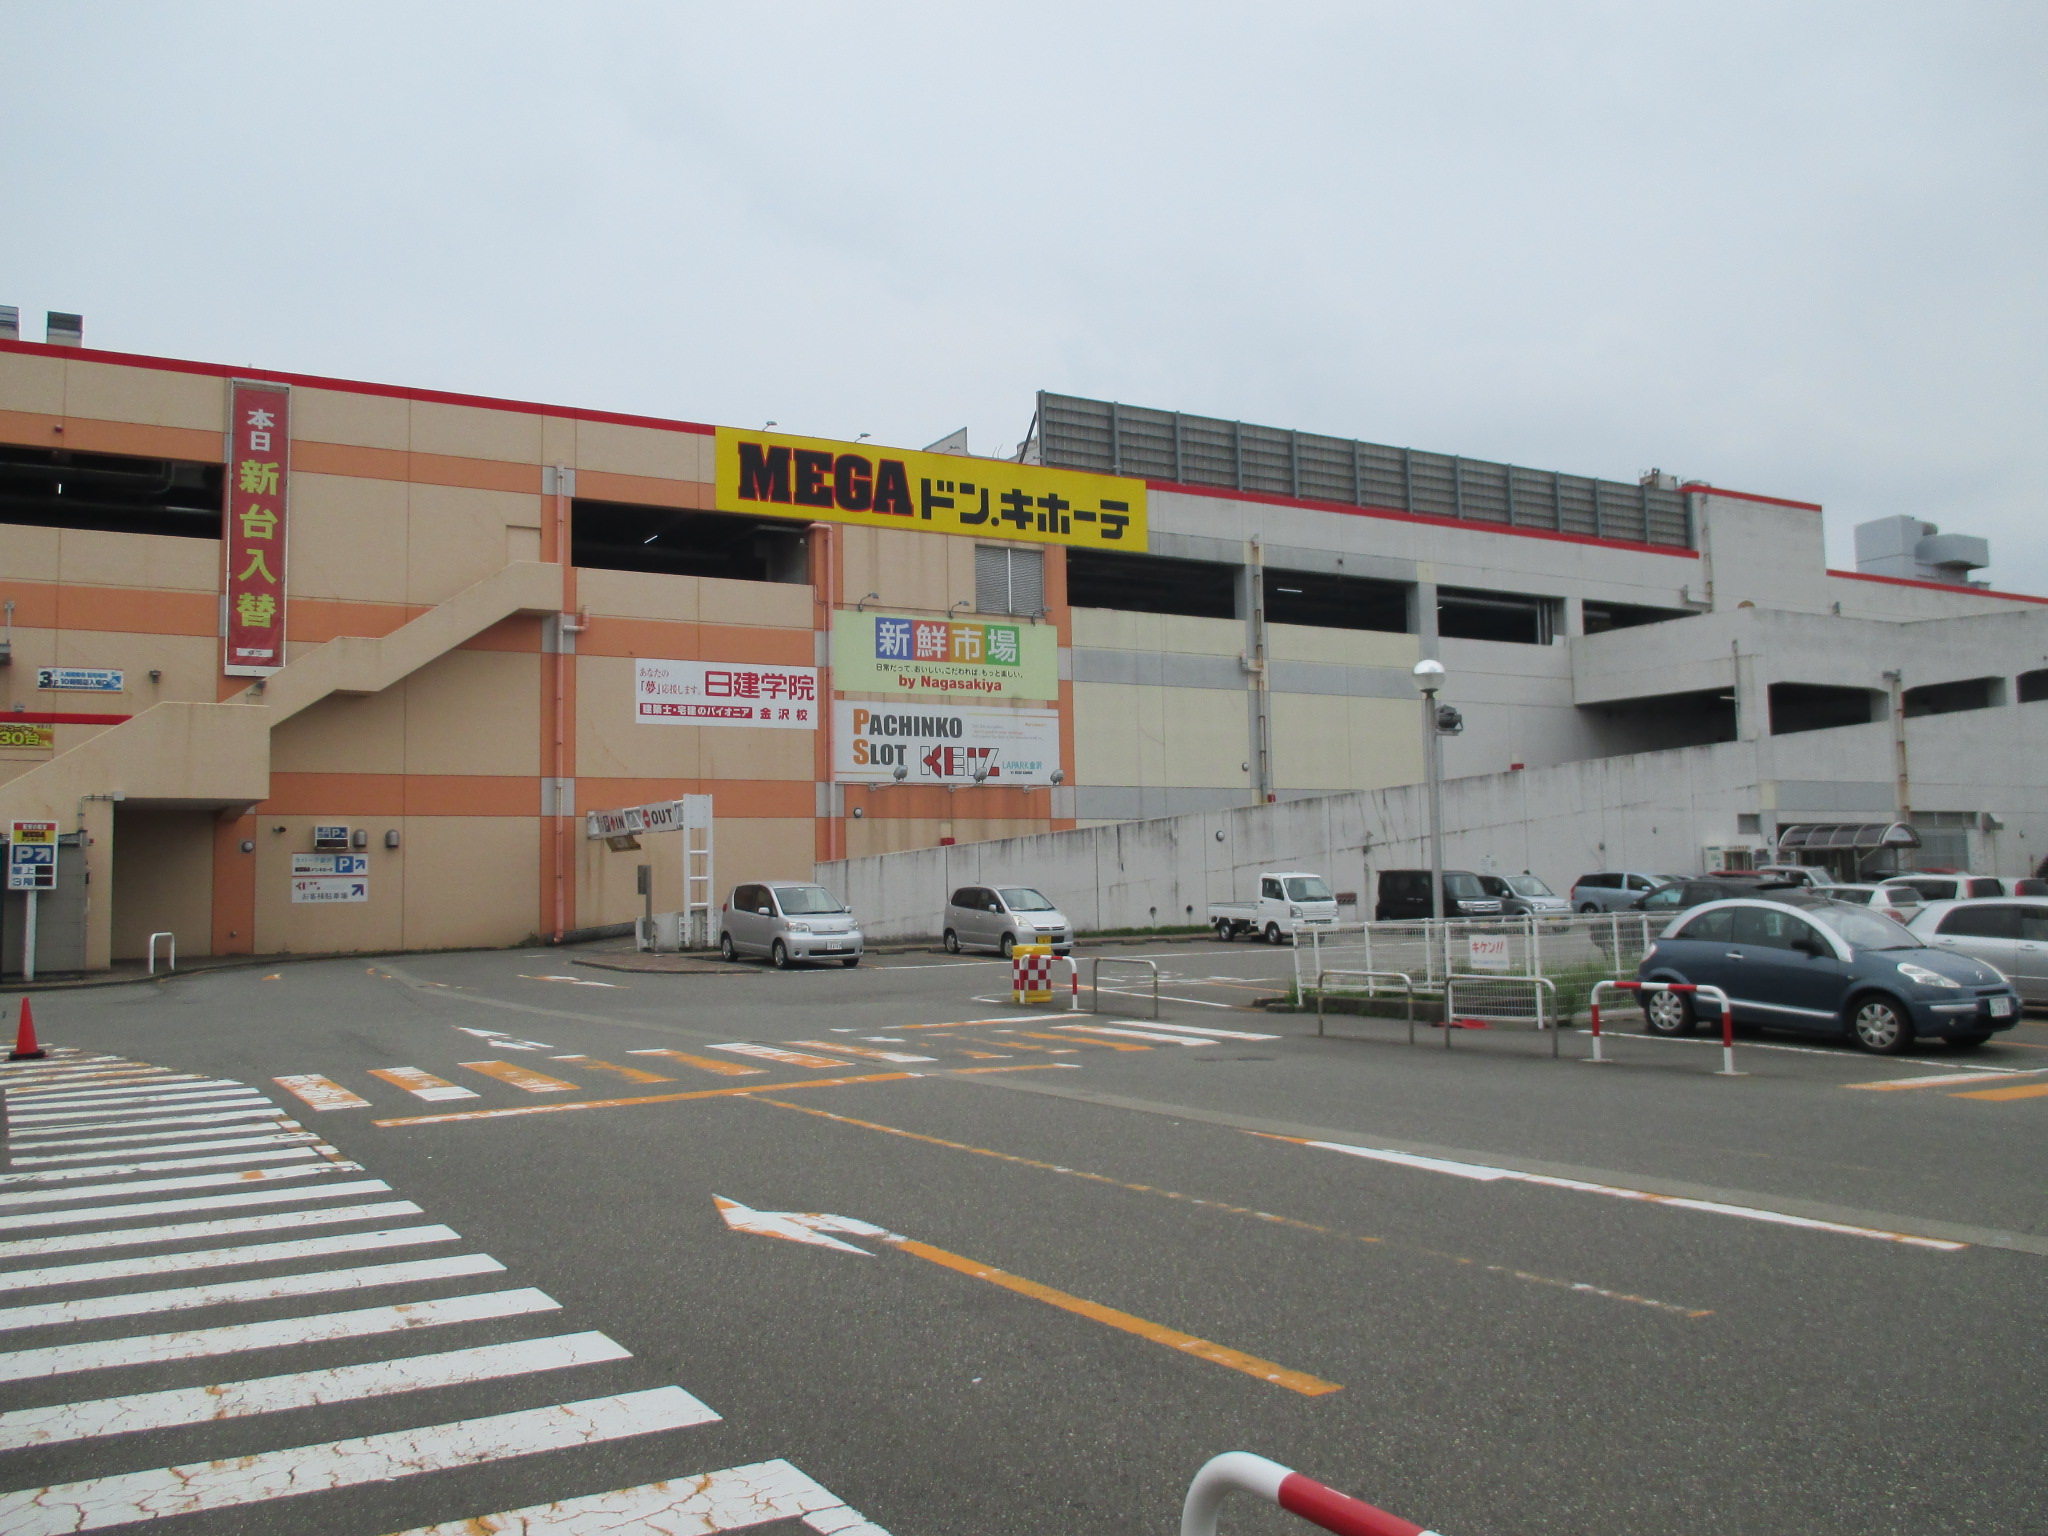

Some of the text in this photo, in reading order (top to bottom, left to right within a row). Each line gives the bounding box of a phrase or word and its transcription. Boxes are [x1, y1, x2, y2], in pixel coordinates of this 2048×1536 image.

[738, 441, 914, 517] MEGA
[879, 621, 1017, 663] 新鮮市場
[640, 668, 669, 677] あなたの
[705, 670, 815, 701] 日建学院
[898, 675, 1002, 693] by Nagasakiya
[853, 708, 963, 738] PACHINKO
[853, 738, 907, 766] SLOT
[615, 816, 625, 829] IN
[651, 808, 672, 824] OUT
[16, 846, 34, 863] P
[339, 858, 350, 872] P
